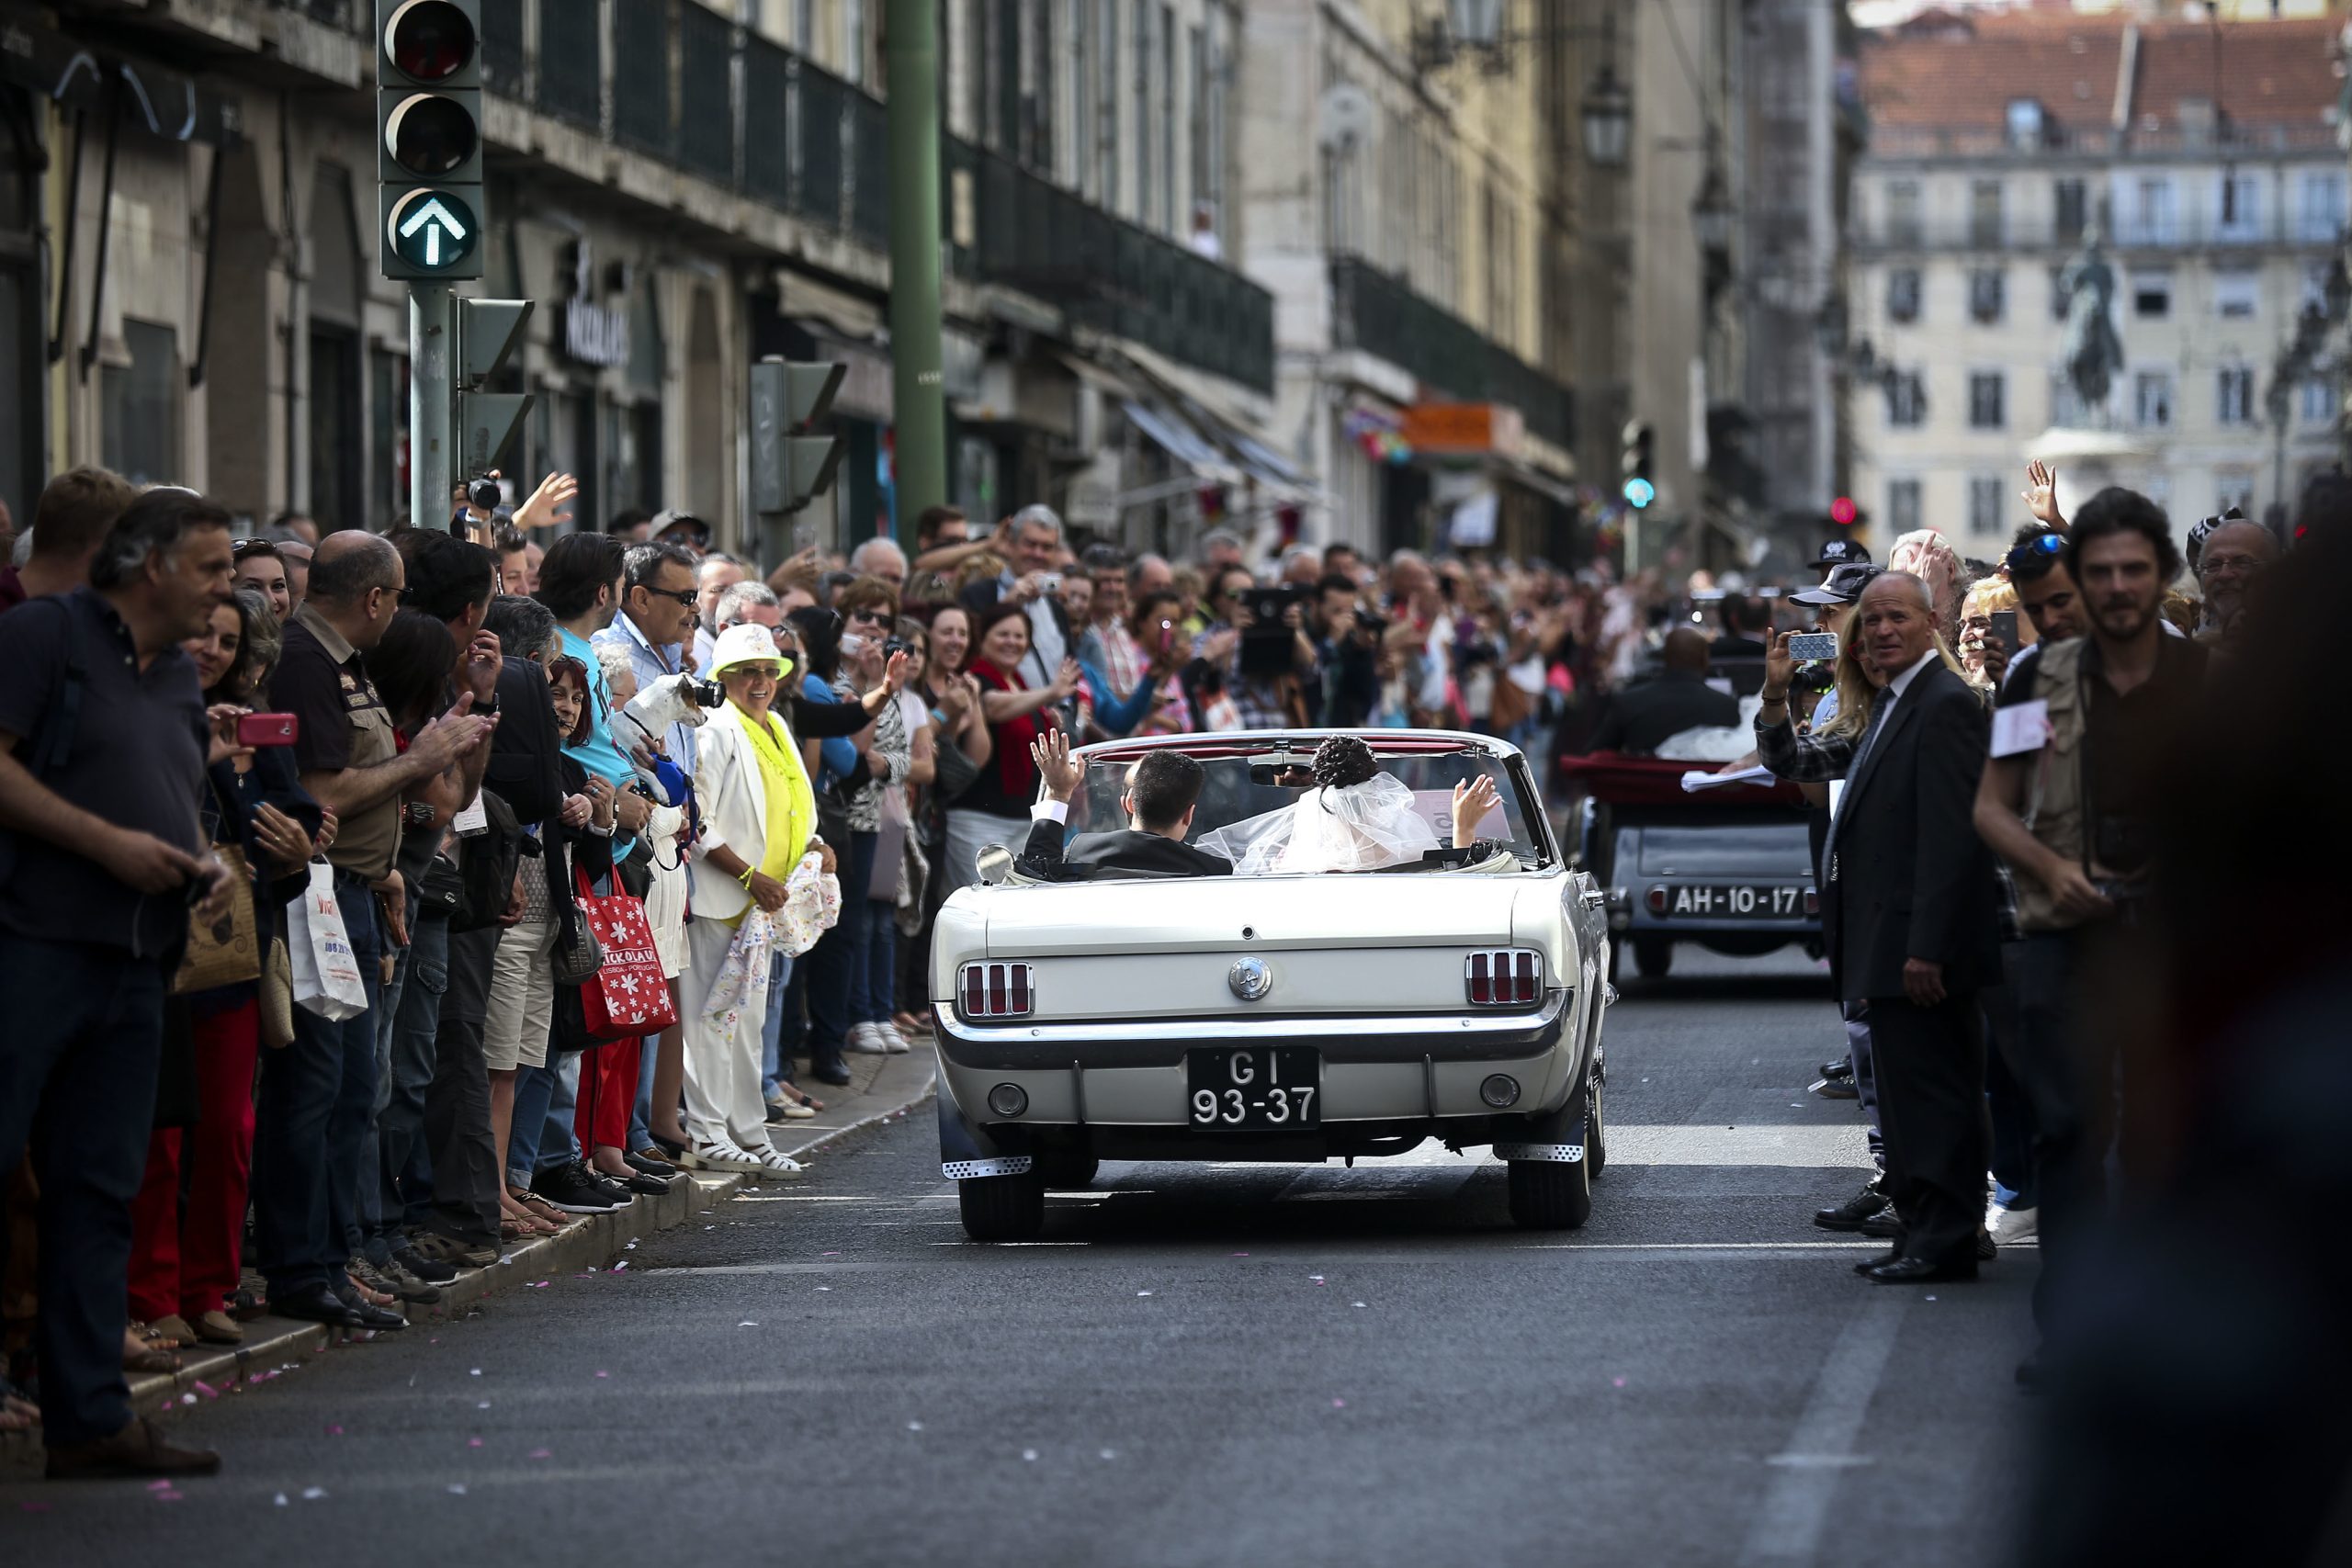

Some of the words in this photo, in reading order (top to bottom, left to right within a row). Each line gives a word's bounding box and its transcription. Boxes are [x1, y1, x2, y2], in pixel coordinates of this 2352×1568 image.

[1674, 886, 1799, 914] AH-10-17
[603, 950, 656, 964] ICKOLAU
[603, 966, 625, 975] LISBOA
[1193, 1087, 1316, 1125] 93-37
